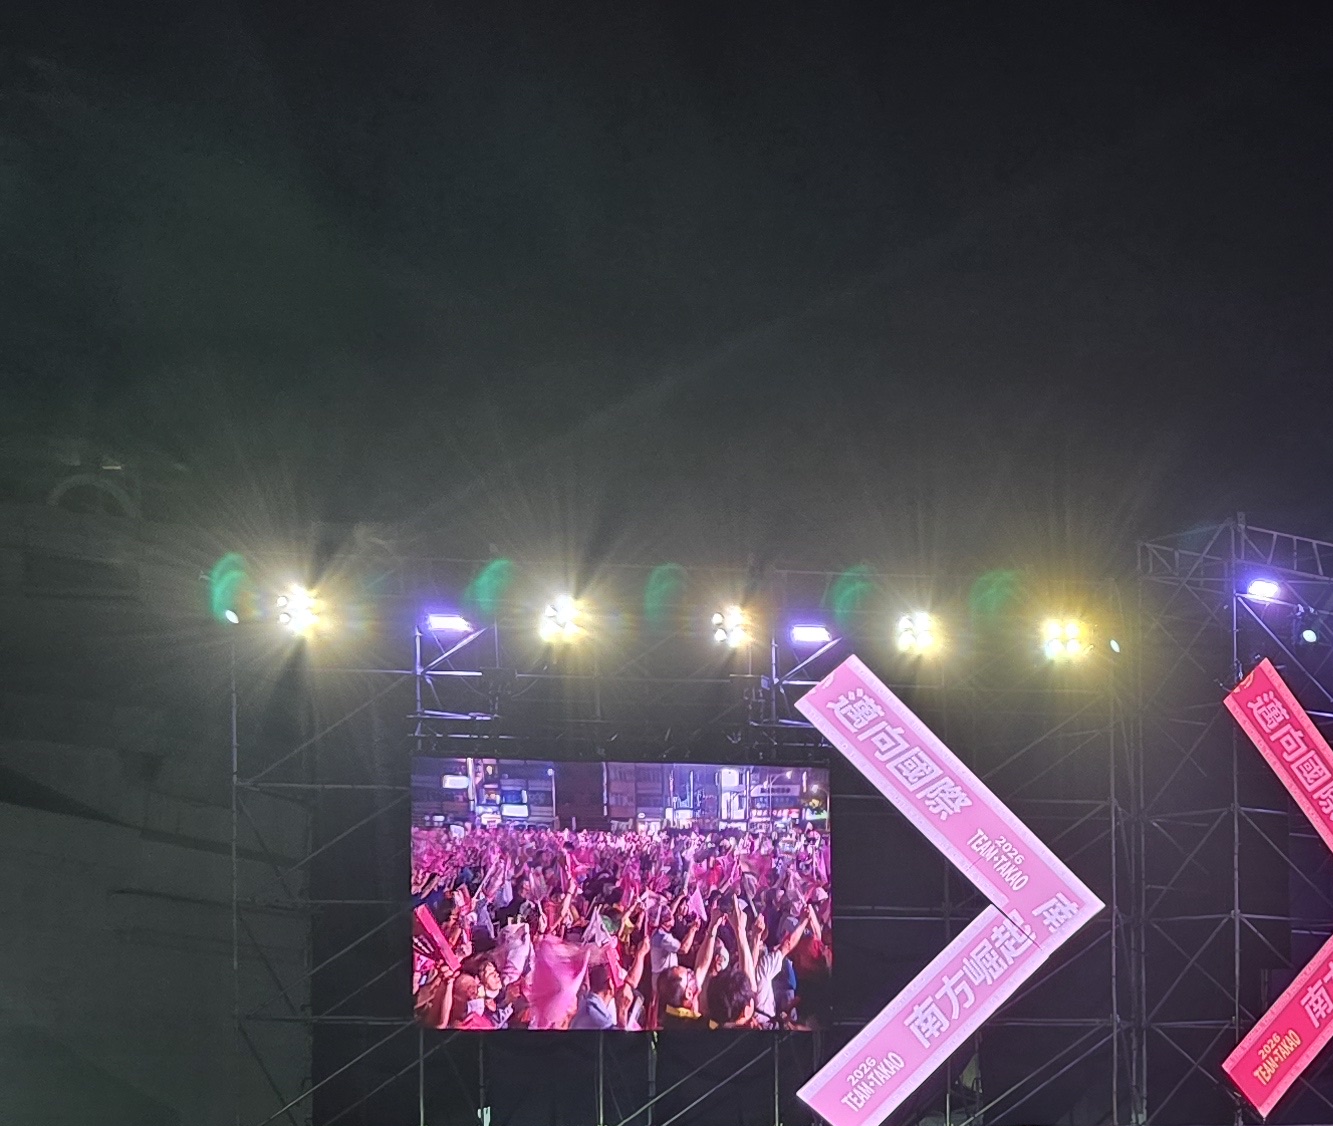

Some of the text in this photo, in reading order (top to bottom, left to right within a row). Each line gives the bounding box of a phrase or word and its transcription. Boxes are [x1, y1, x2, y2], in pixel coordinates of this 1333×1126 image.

[826, 687, 973, 822] 邁向國際
[966, 828, 1029, 893] TEAM TAKAO
[992, 834, 1025, 866] 2026
[904, 908, 1038, 1049] 南方崛起
[846, 1055, 877, 1087] 2026
[1254, 1031, 1302, 1086] TEAM TAKAO
[1258, 1033, 1281, 1061] 2026
[840, 1050, 905, 1112] TEAM TAKAO
